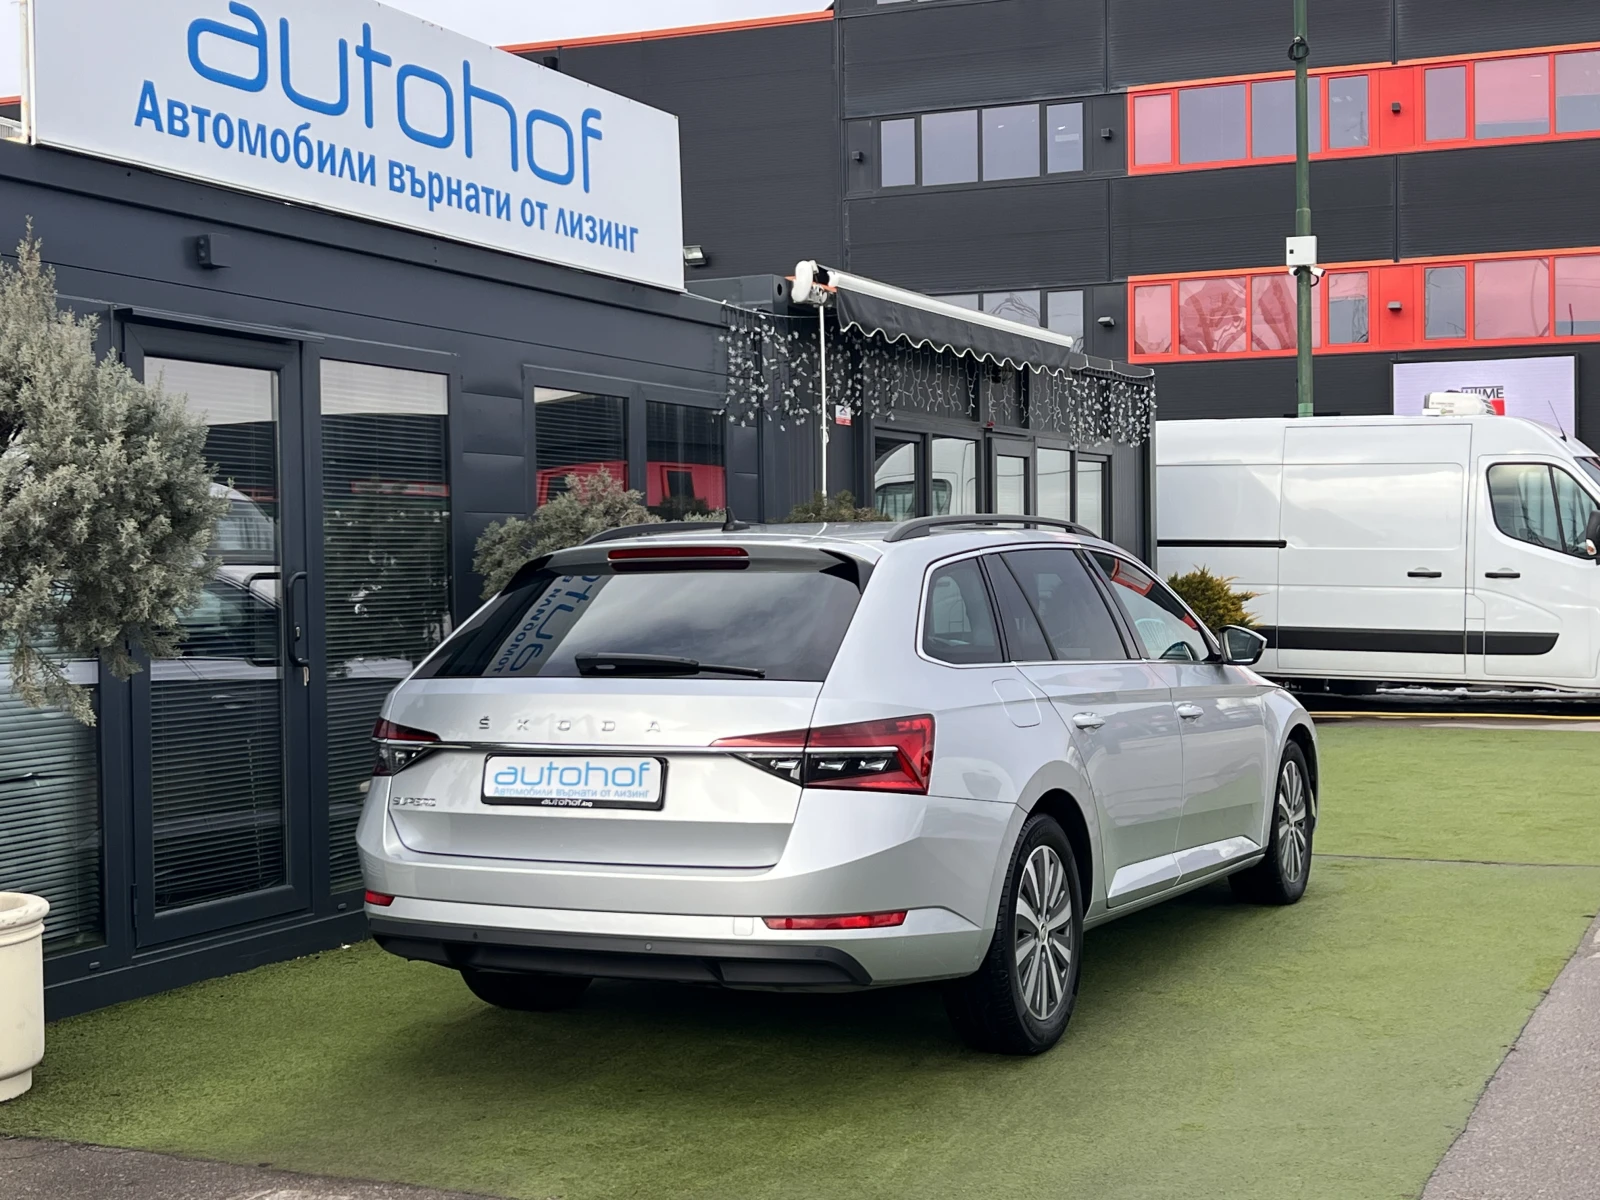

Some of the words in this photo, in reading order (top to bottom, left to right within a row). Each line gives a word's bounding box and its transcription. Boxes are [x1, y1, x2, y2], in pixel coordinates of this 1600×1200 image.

[186, 0, 603, 194] autohof
[134, 79, 376, 187] Автомобили
[388, 159, 511, 222] върнати
[520, 197, 548, 231] от
[555, 207, 639, 253] лизинг
[492, 786, 553, 797] Автомобили
[555, 788, 598, 798] върнати
[600, 788, 611, 798] от
[613, 789, 650, 799] лизинг
[493, 761, 650, 787] autohof
